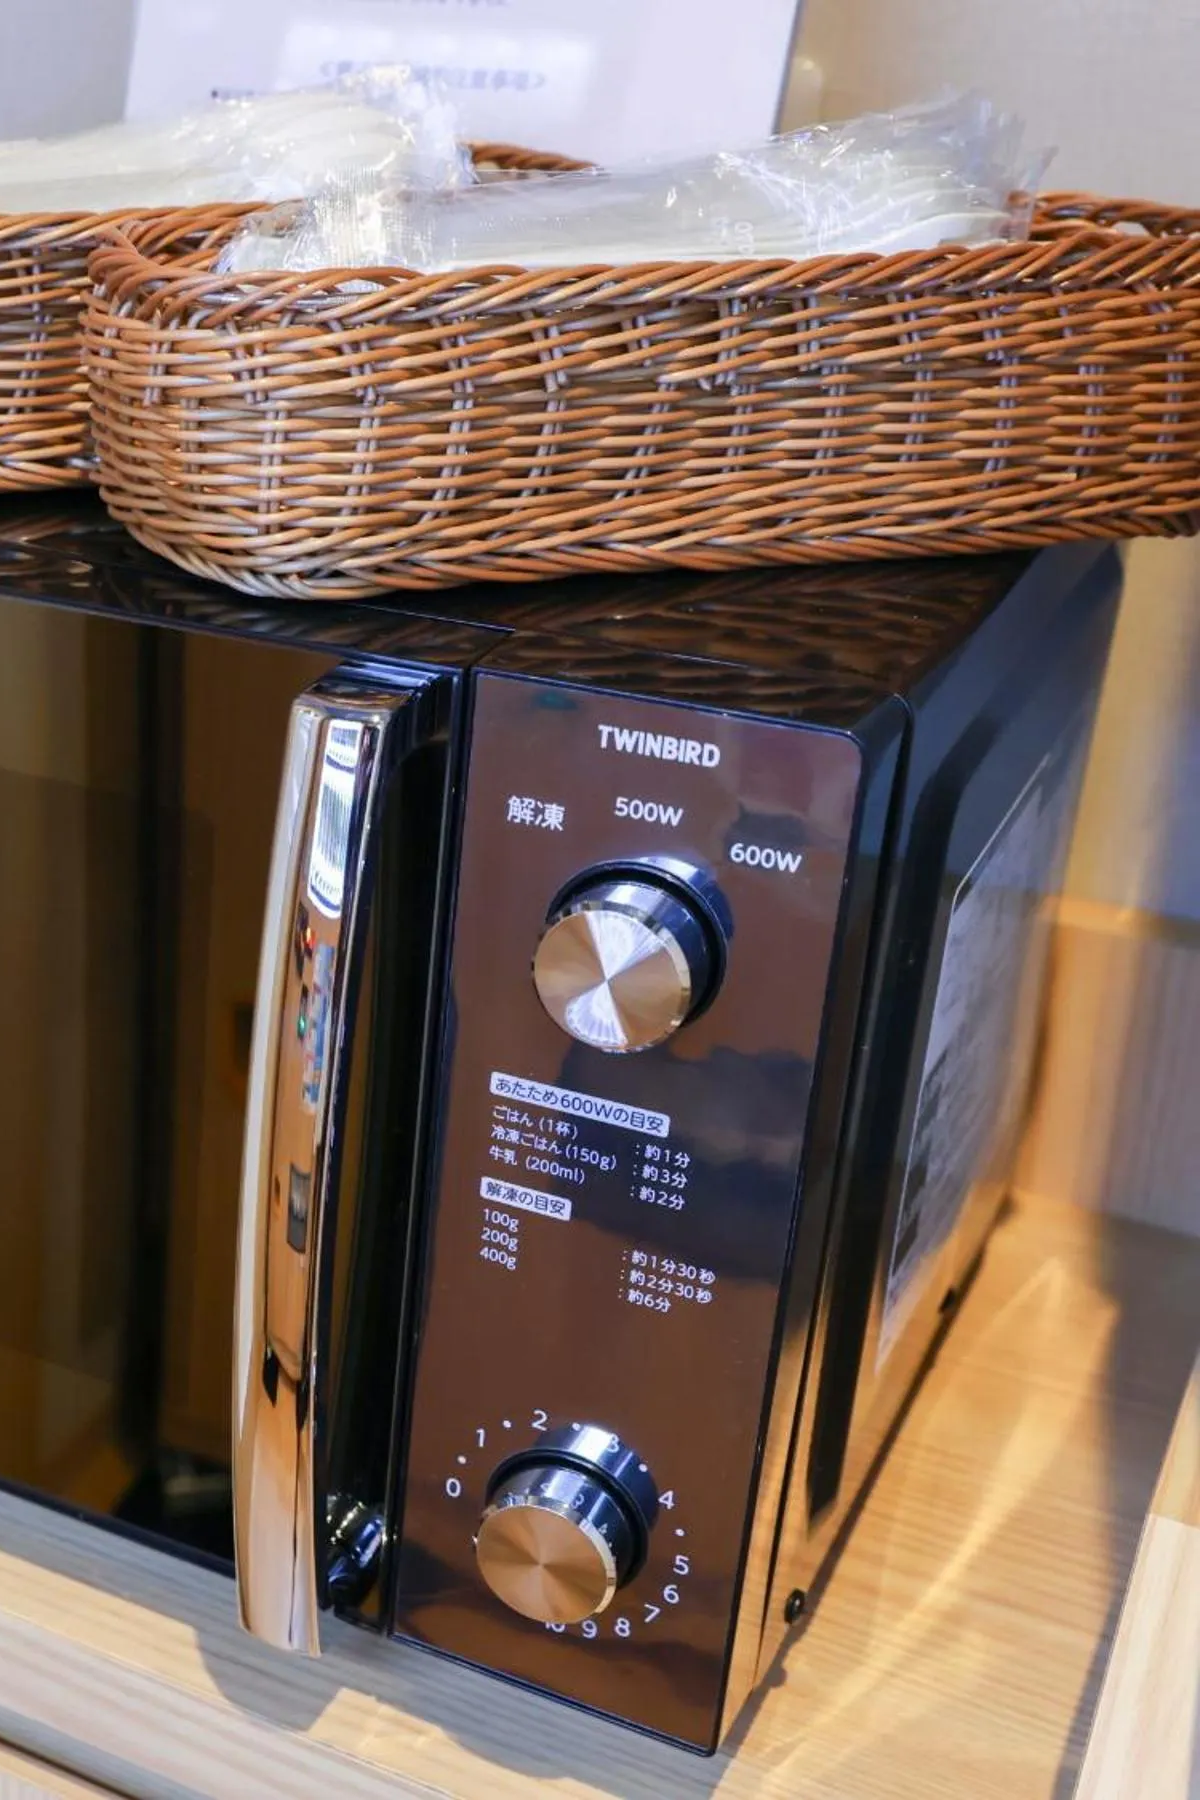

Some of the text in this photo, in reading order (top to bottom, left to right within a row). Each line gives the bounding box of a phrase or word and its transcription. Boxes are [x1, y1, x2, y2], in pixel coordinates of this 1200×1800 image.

[598, 724, 721, 768] TWINBIRD
[506, 795, 566, 831] 解凍
[614, 797, 683, 828] 500W
[730, 842, 802, 874] 600W
[494, 1078, 666, 1134] あたため600Wの目安
[485, 1181, 567, 1217] 解凍の目安
[483, 1208, 520, 1233] 100g
[481, 1228, 519, 1252] 200g
[480, 1246, 517, 1271] 400g
[531, 1409, 548, 1431] 2
[476, 1428, 486, 1447] 1
[607, 1433, 620, 1453] 3
[445, 1477, 461, 1498] 0
[658, 1490, 675, 1509] 4
[673, 1555, 690, 1576] 5
[663, 1584, 680, 1604] 6
[644, 1603, 661, 1623] 7
[582, 1619, 598, 1639] 9
[614, 1617, 631, 1637] 8
